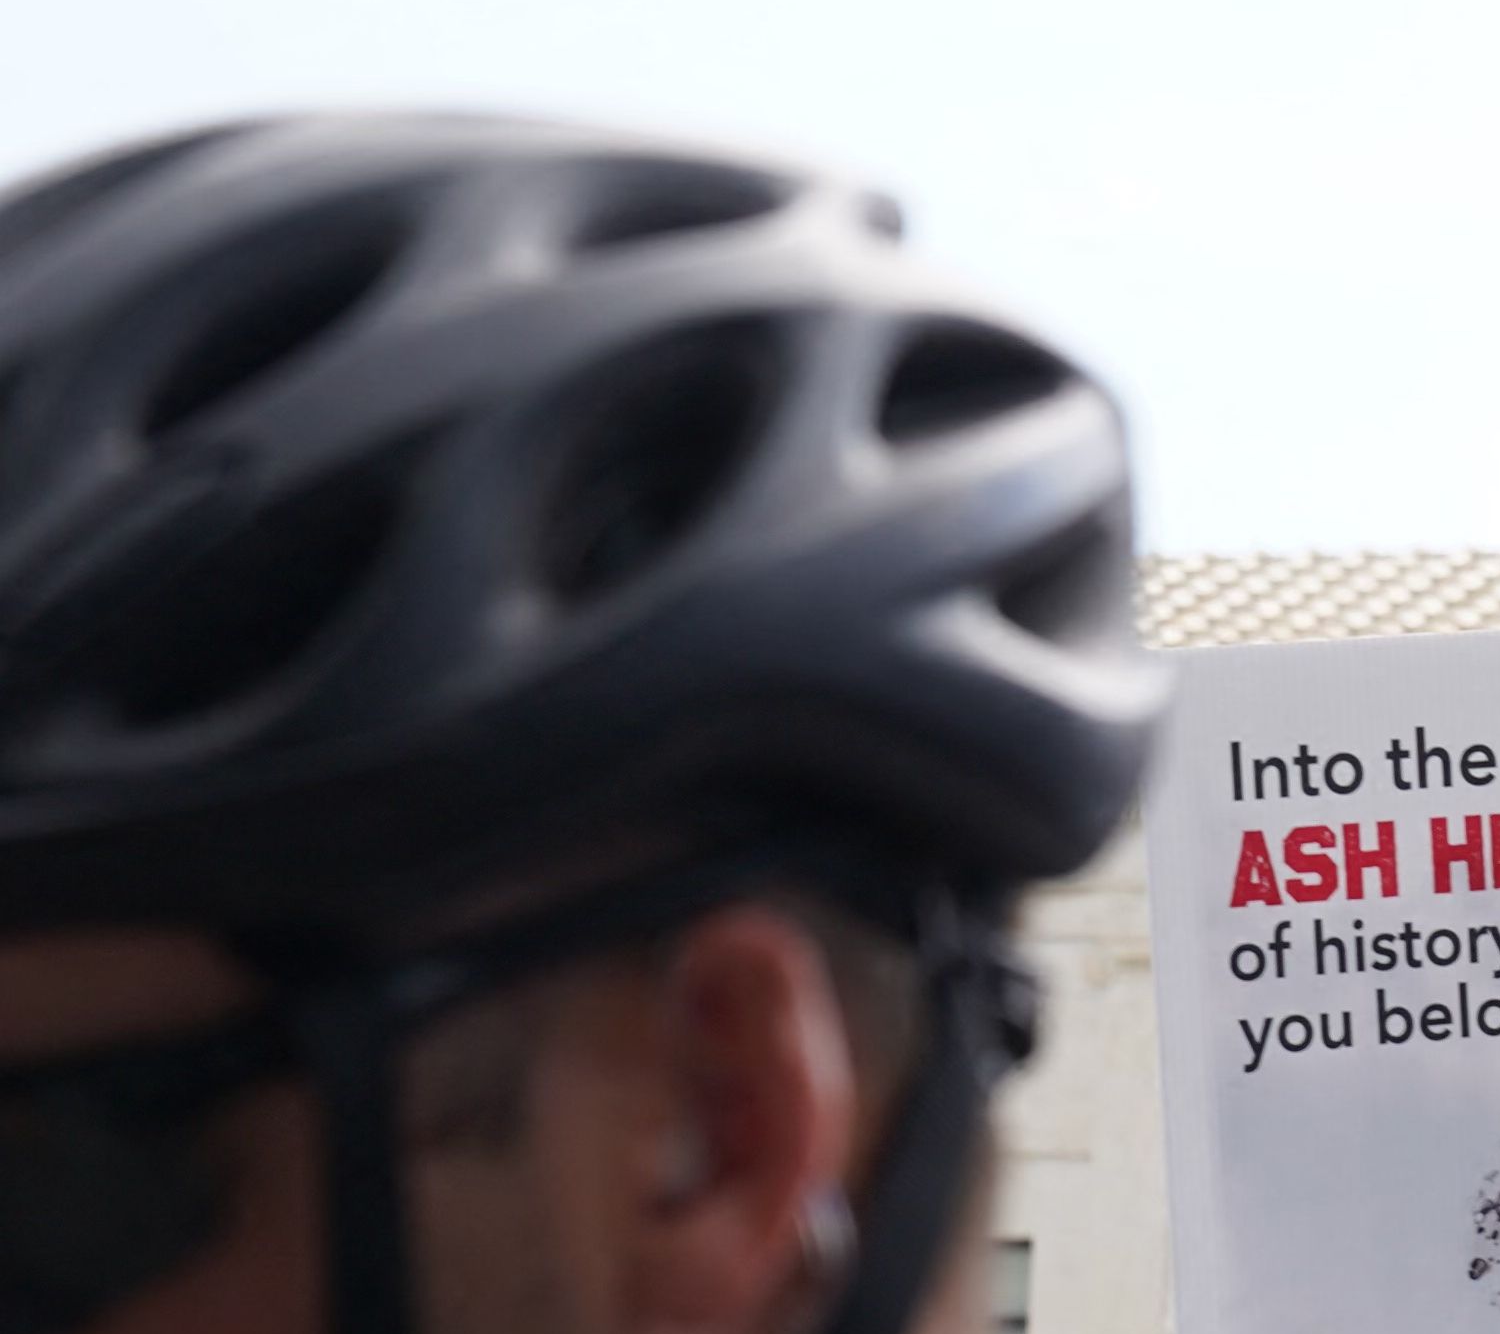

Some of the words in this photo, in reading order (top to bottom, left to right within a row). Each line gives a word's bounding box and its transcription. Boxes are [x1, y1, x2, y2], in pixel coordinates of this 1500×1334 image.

[1230, 741, 1364, 801] Into
[1386, 726, 1498, 791] the
[1229, 821, 1399, 907] ASH
[1230, 921, 1291, 981] of
[1238, 1010, 1353, 1073] you
